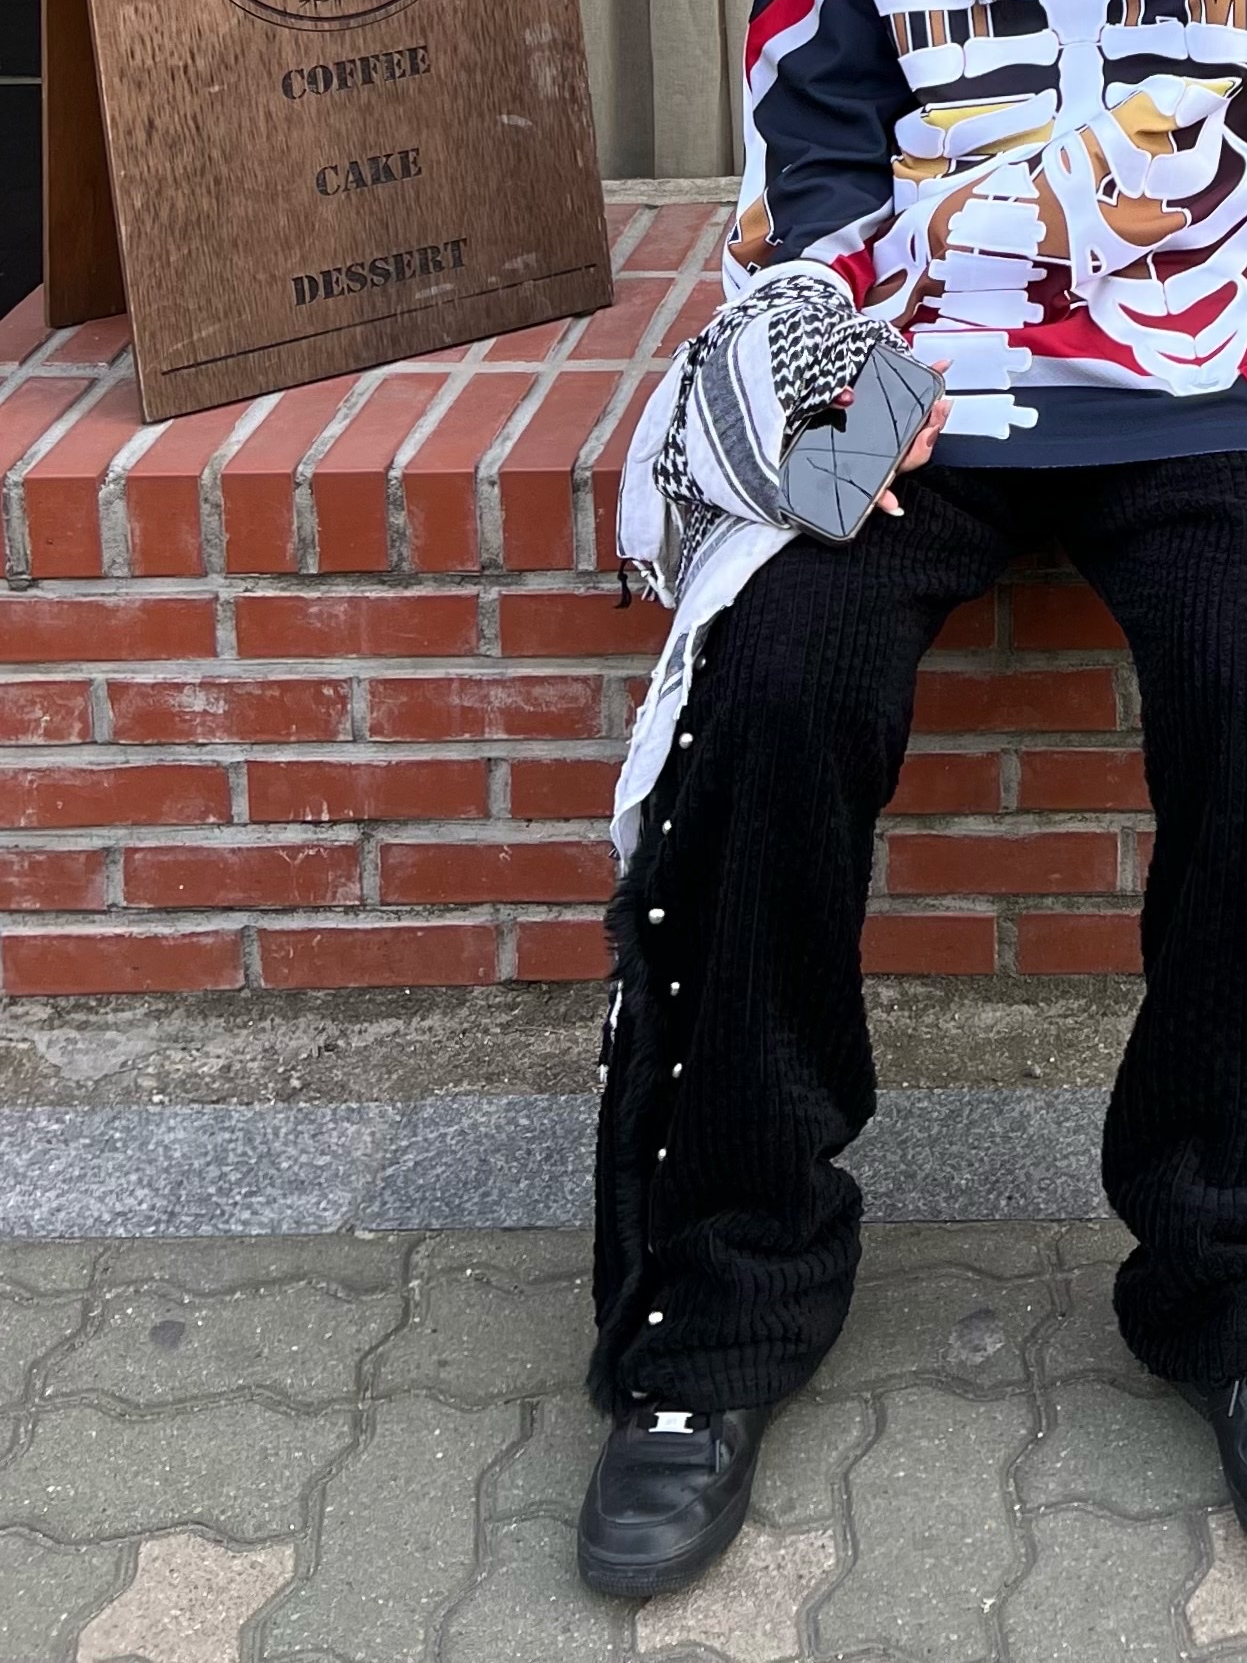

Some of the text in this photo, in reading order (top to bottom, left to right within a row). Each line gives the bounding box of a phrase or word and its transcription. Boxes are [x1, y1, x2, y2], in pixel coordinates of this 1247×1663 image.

[281, 45, 432, 101] COFFEE
[315, 148, 423, 197] CAKE
[290, 238, 469, 307] DESSERT
